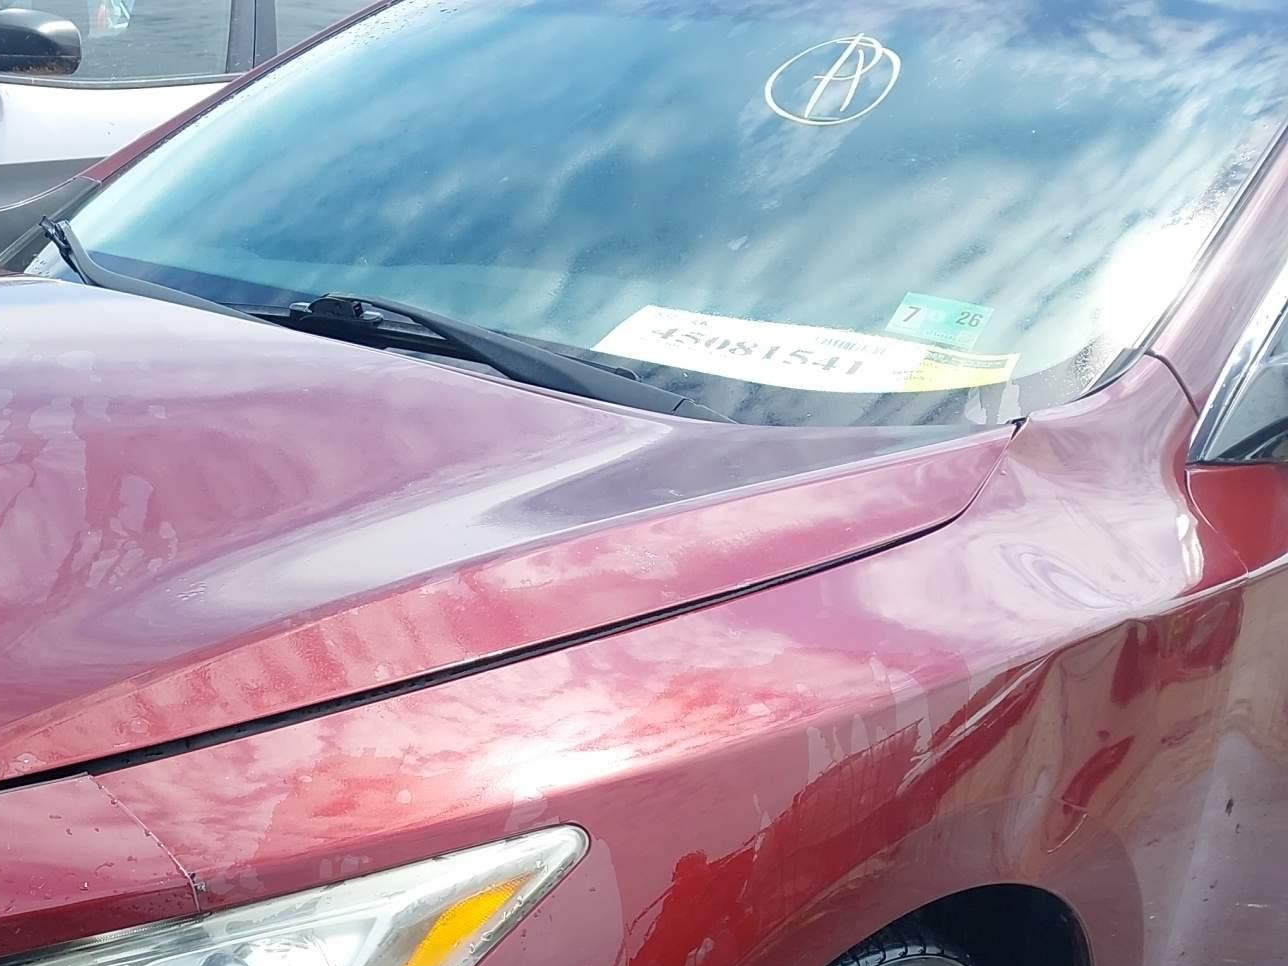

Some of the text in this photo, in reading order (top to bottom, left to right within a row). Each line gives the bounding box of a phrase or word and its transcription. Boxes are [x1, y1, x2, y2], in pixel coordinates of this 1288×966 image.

[902, 306, 983, 328] 7 26
[649, 326, 865, 375] 45081541
